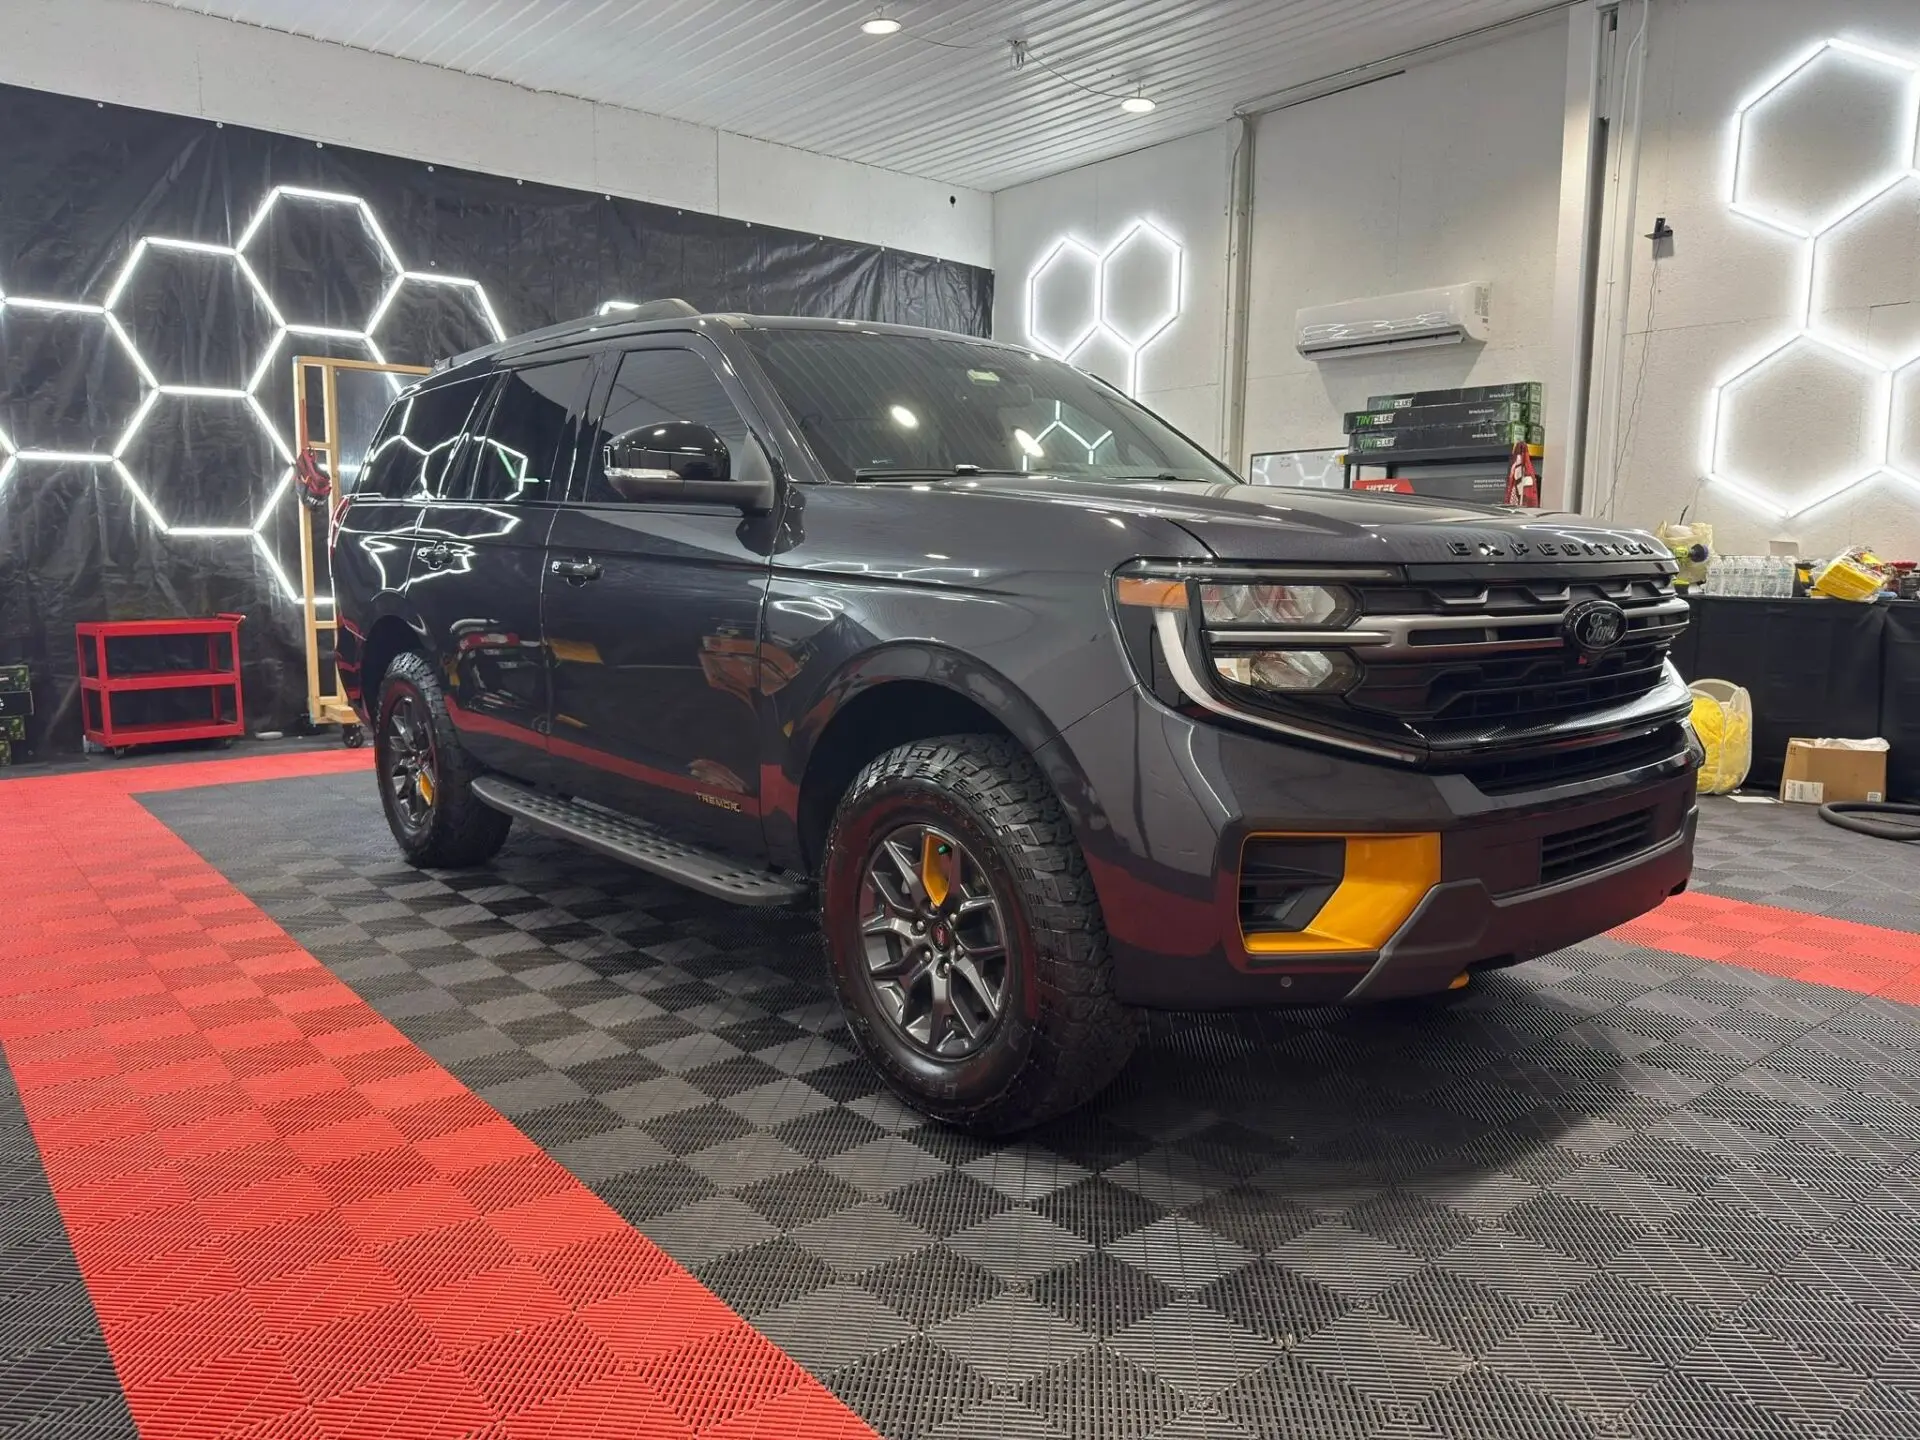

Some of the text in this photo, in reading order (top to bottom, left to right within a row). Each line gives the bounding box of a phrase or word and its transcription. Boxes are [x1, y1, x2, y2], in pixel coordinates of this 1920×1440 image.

[1447, 541, 1655, 556] EXPEDITION
[1585, 611, 1619, 645] Ford
[695, 791, 741, 812] TREMOR
